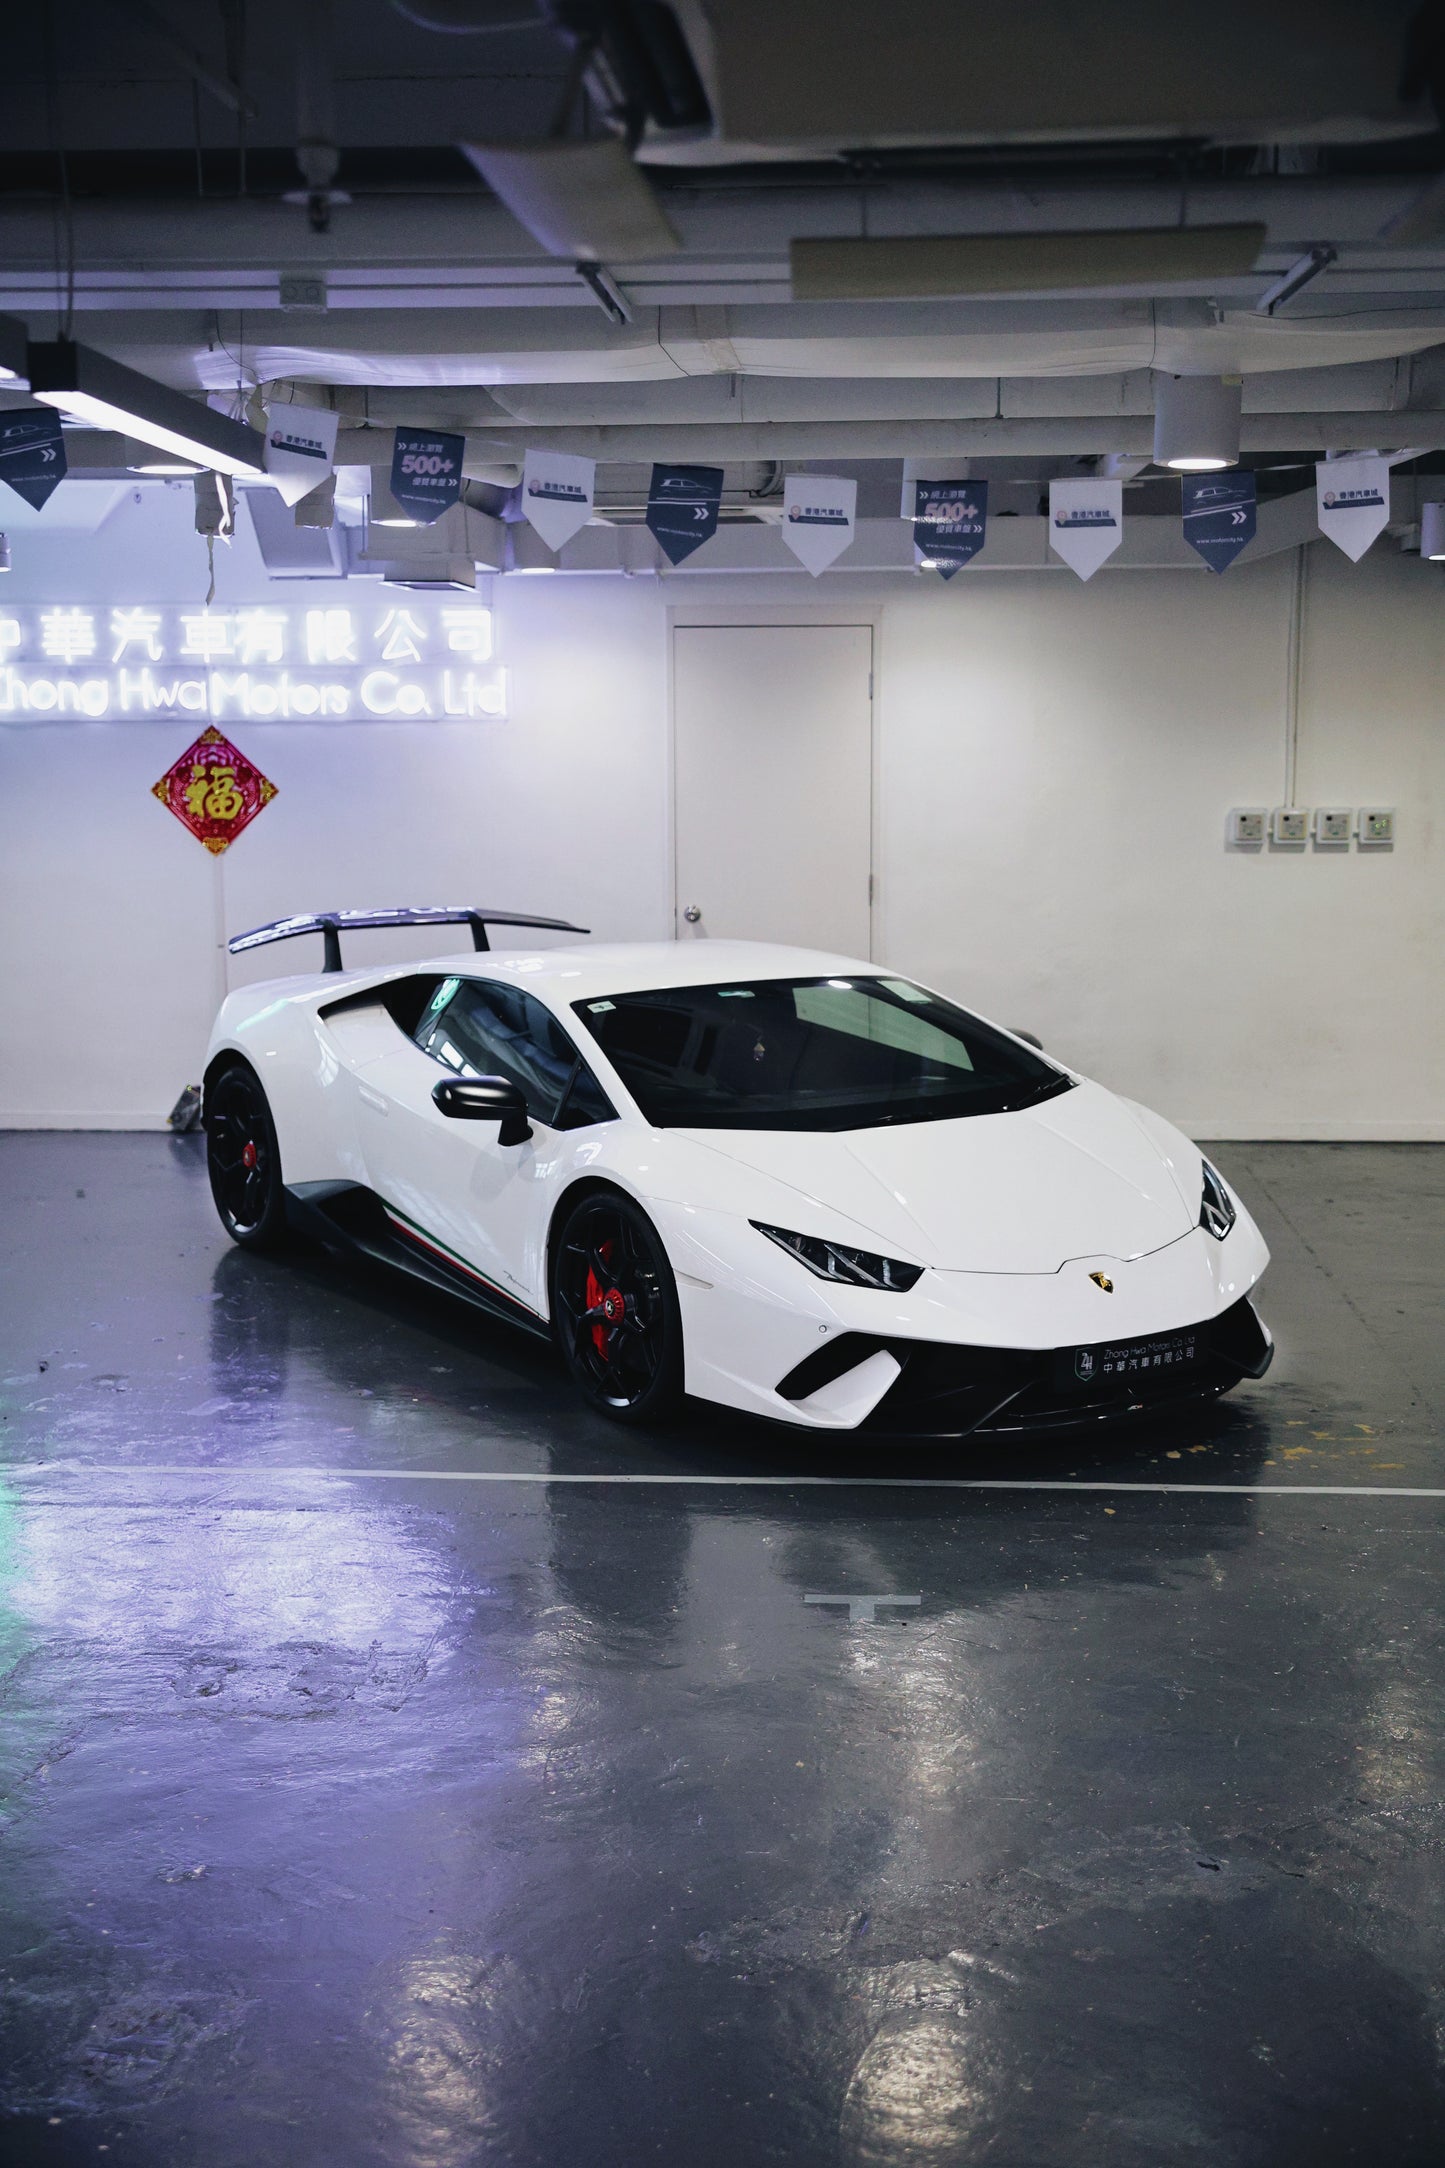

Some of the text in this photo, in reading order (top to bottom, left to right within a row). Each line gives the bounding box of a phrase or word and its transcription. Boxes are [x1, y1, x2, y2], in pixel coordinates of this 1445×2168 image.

[401, 454, 454, 475] 500+
[924, 502, 978, 523] 500+
[119, 668, 207, 711] Hwa
[209, 672, 350, 716] Motors
[443, 667, 508, 717] Ltd
[185, 764, 244, 820] 福
[1103, 1348, 1129, 1360] Zhong
